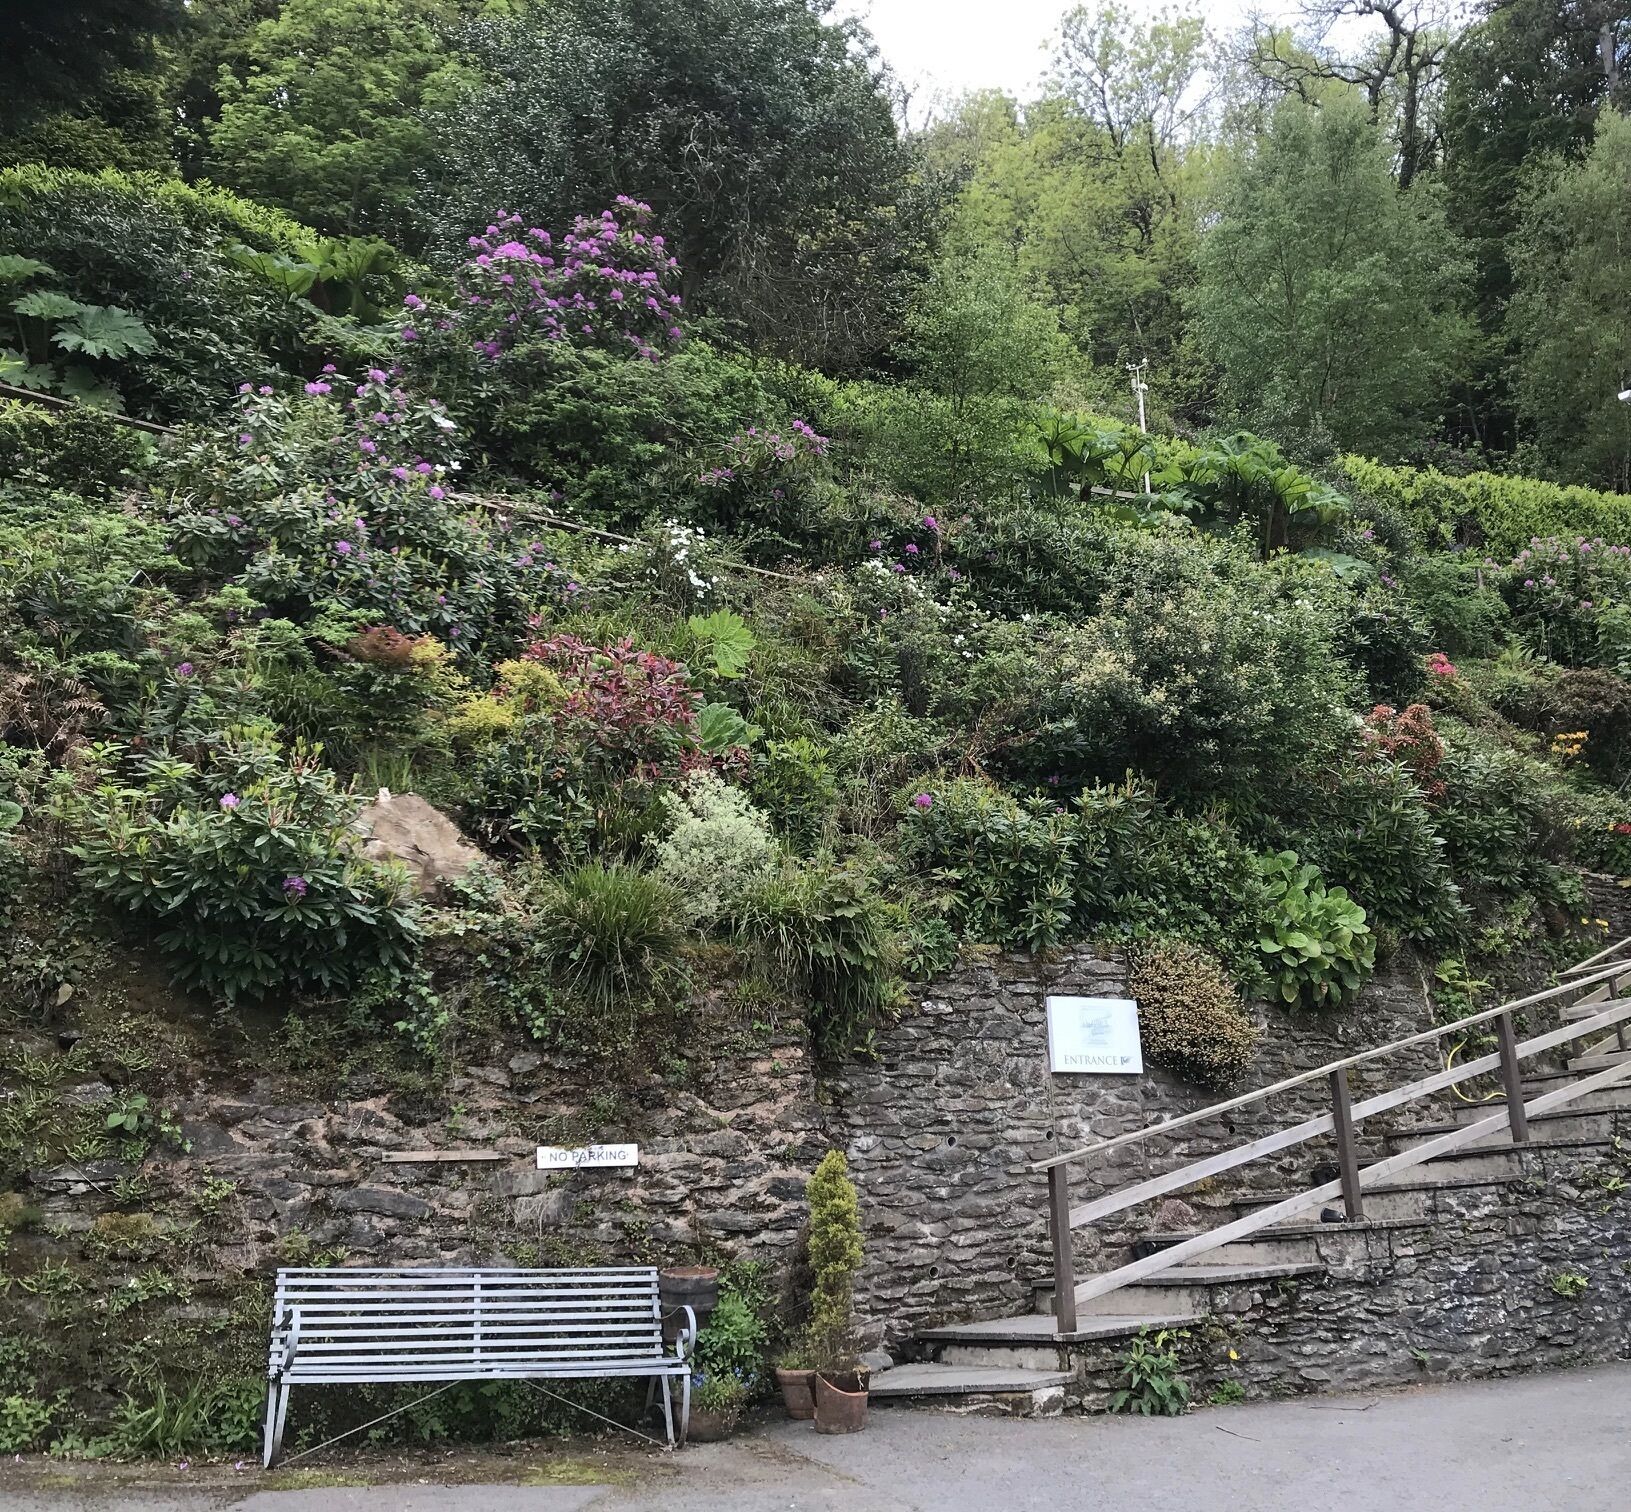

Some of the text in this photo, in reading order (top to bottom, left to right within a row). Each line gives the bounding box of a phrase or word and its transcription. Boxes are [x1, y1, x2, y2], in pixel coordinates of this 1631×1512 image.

[1064, 1054, 1118, 1066] ENTRANCE
[549, 1151, 626, 1162] NO PARKING
